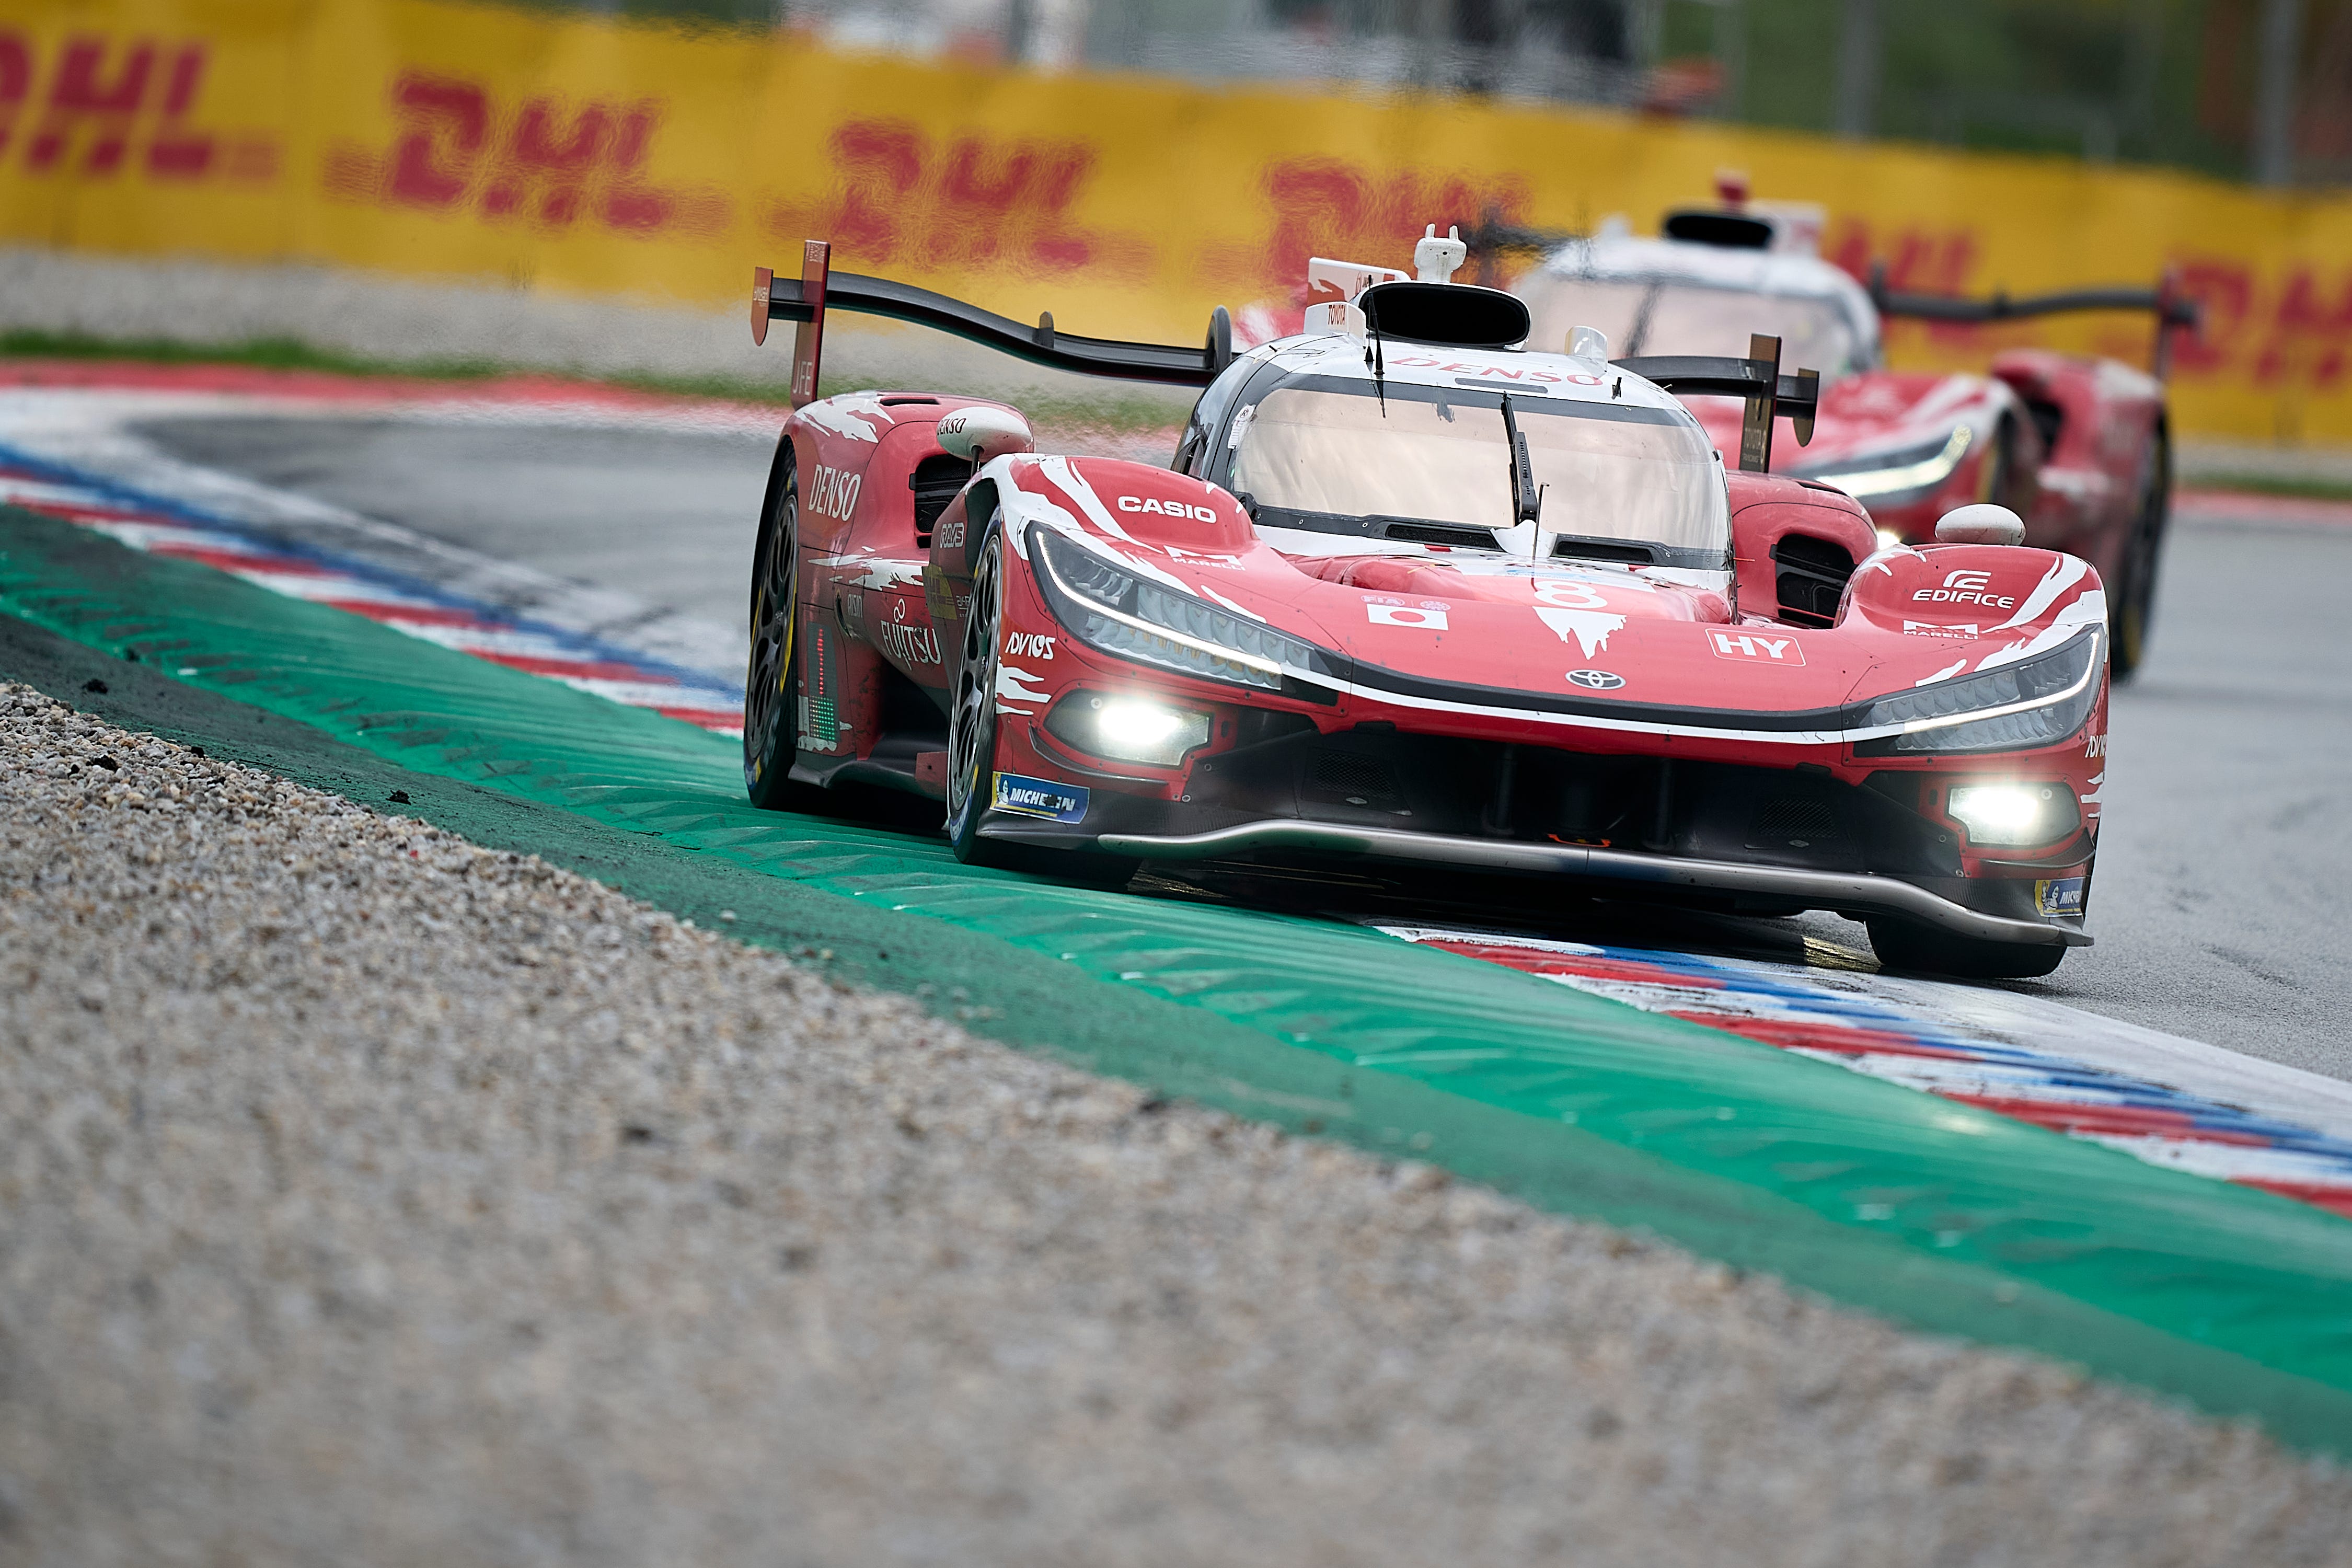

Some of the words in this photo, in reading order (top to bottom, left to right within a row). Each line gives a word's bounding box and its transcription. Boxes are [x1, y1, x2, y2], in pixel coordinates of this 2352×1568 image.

[389, 68, 670, 227] DHL
[826, 115, 1095, 271] DHL
[1328, 304, 1346, 326] TOYOTA
[792, 361, 812, 396] JFE
[1388, 357, 1604, 386] DENSO
[937, 418, 966, 436] DENSO
[809, 464, 861, 521] DENSO
[1118, 495, 1217, 523] CASIO
[940, 522, 964, 548] RAYS
[1172, 557, 1246, 571] MARELLI
[847, 594, 863, 618] AISIN
[1534, 580, 1608, 609] 8
[1912, 589, 2015, 609] EDIFICE
[881, 620, 941, 671] FUJITSU
[1714, 633, 1791, 659] HY
[1903, 630, 1978, 640] MARELLI
[1009, 788, 1076, 812] MICHEIN
